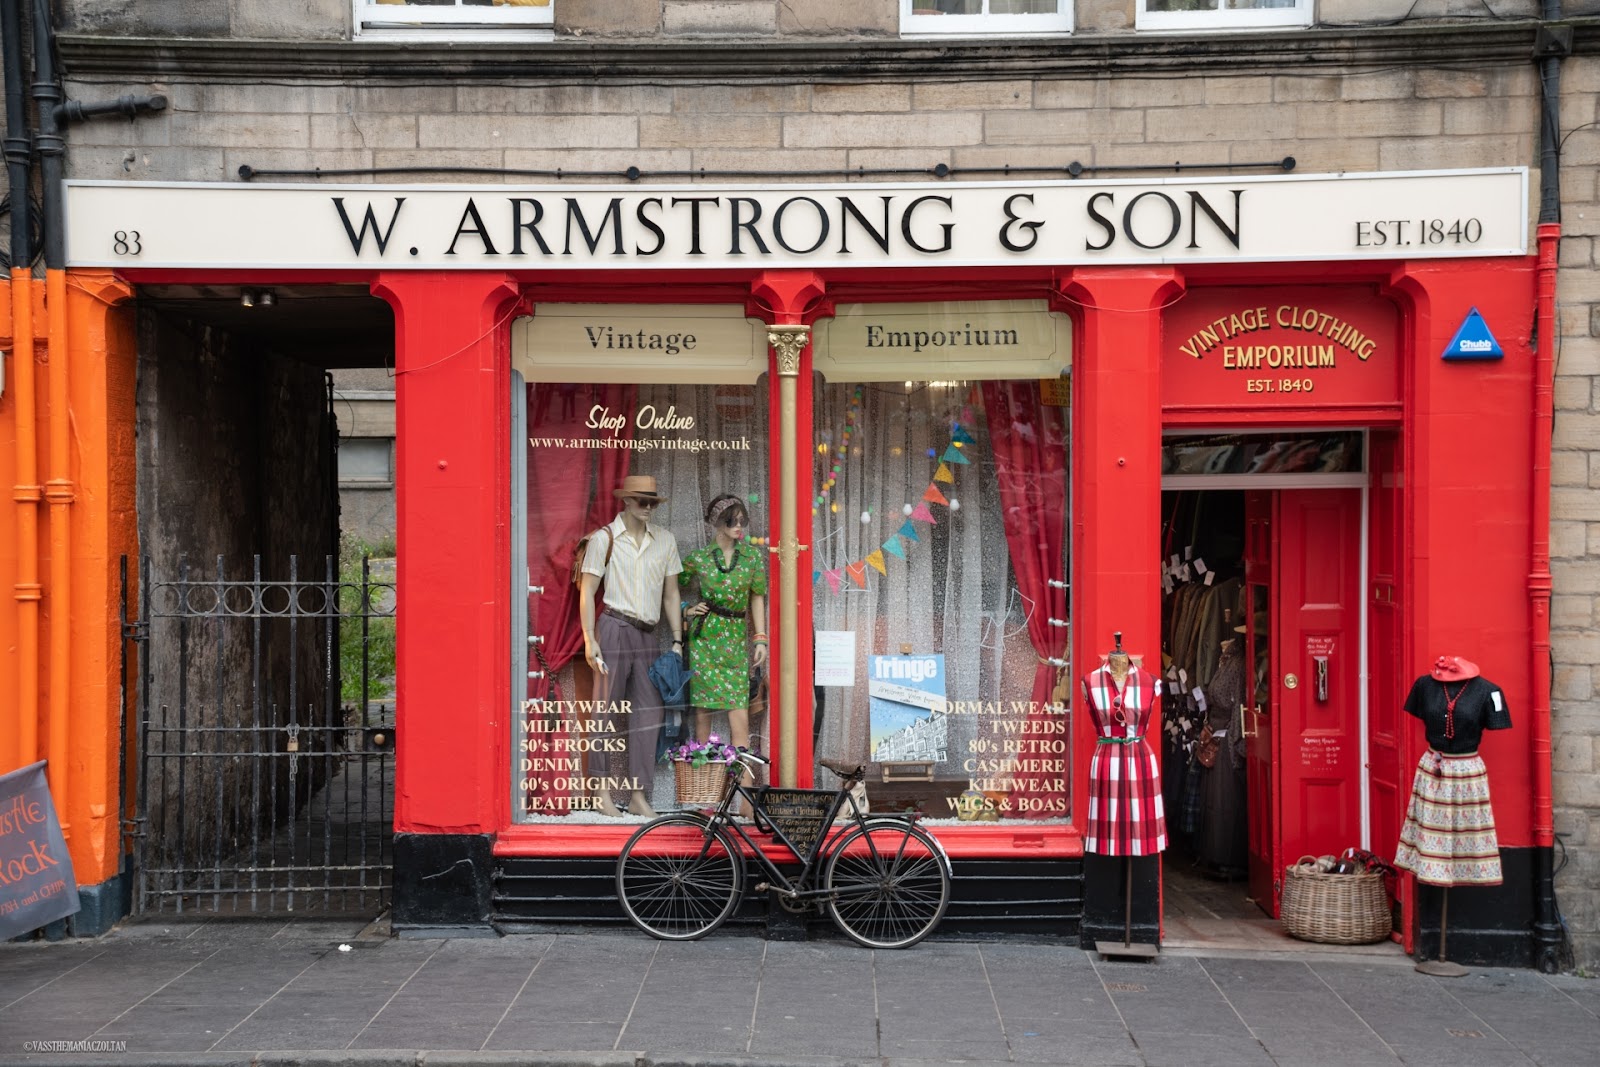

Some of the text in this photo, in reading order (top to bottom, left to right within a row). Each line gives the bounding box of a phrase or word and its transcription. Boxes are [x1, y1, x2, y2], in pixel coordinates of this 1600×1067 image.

[331, 189, 1247, 257] W. ARMSTRONG & SON
[1355, 217, 1483, 247] EST. 1840
[113, 230, 142, 255] 83
[865, 323, 1019, 352] Emporium
[1179, 305, 1377, 361] VINTAGE CLOTHING
[584, 326, 697, 355] Vintage
[1460, 340, 1492, 348] Chubb
[1223, 345, 1335, 369] EMPORIUM
[1247, 378, 1313, 392] EST. 1840
[585, 404, 695, 437] Shop Online
[529, 435, 751, 453] www.armstrongsvintage.co.uk
[875, 656, 937, 682] fringe
[520, 700, 633, 714] PARTYWEAR
[1010, 701, 1066, 715] WEAR
[520, 720, 617, 733] MILITARIA
[990, 720, 1066, 734] TWEEDS
[520, 739, 627, 752] 50's FROCKS
[968, 740, 1066, 753] 80's RETRO
[520, 758, 580, 771] DENIM
[963, 759, 1066, 772] CASHMERE
[520, 777, 644, 791] 60's ORIGINAL
[968, 779, 1066, 792] KILTWEAR
[520, 797, 604, 810] LEATHER
[946, 797, 1066, 811] WIGS & BOAS
